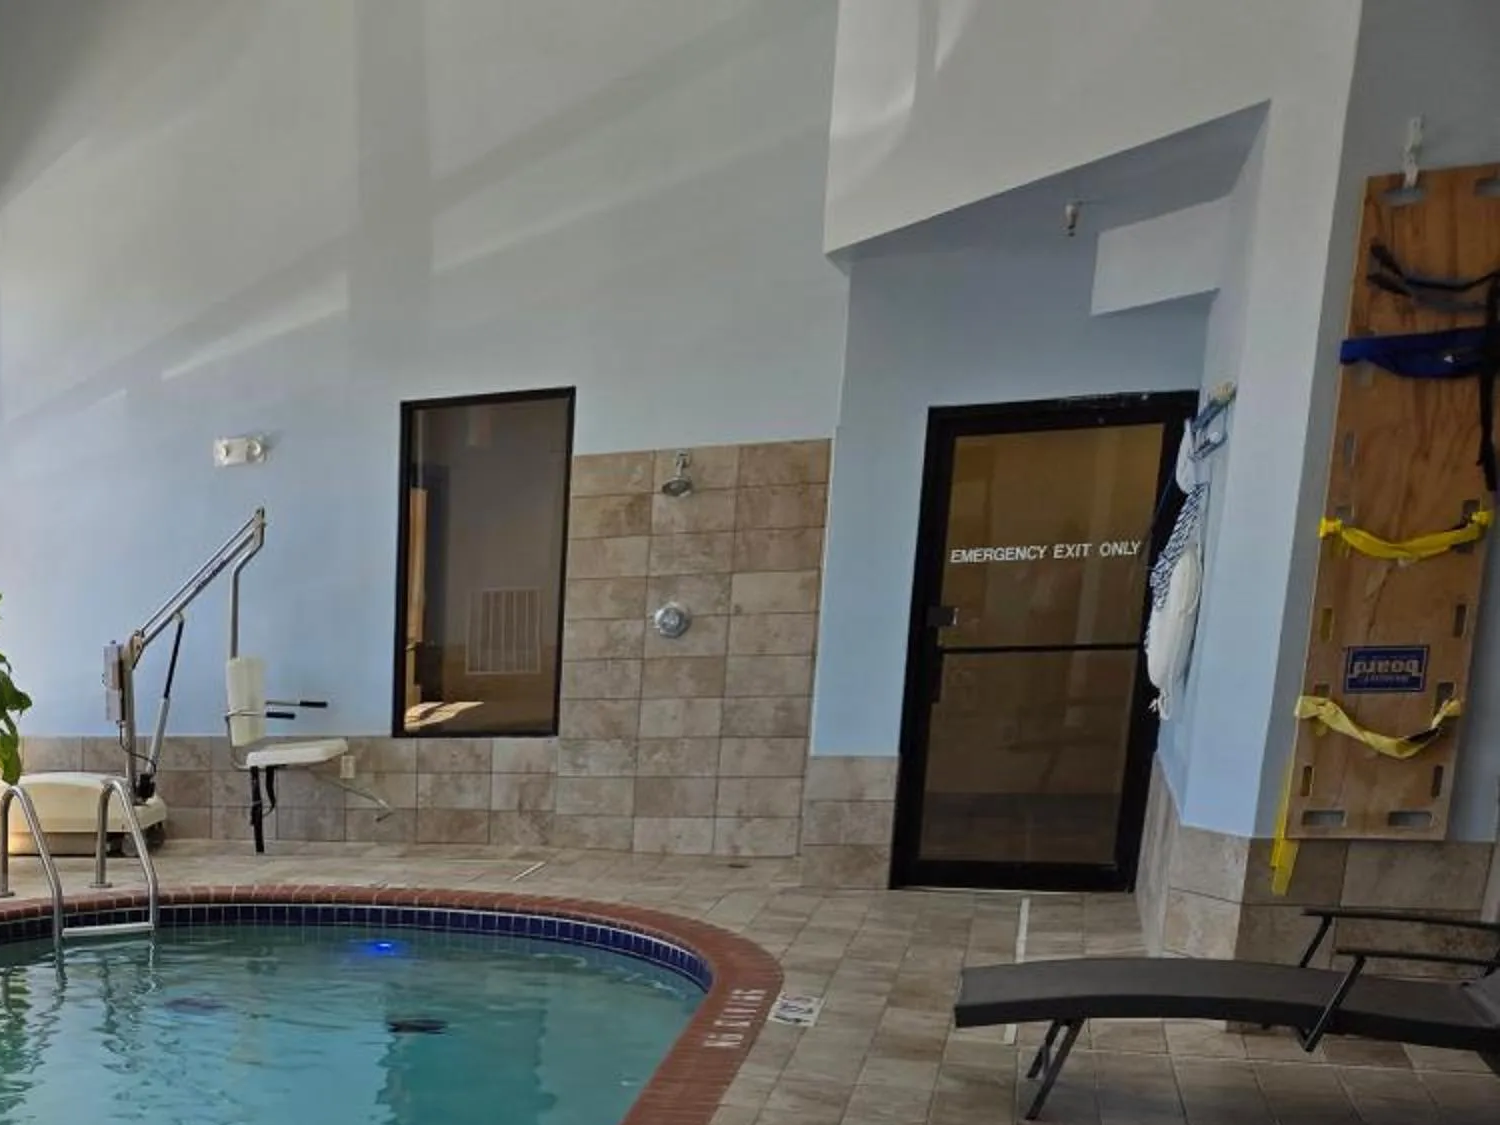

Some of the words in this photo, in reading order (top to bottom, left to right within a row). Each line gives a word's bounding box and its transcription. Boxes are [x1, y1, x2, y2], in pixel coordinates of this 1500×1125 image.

[950, 546, 1048, 564] EMERGENCY
[1053, 543, 1093, 560] EXIT
[1099, 540, 1142, 557] ONLY
